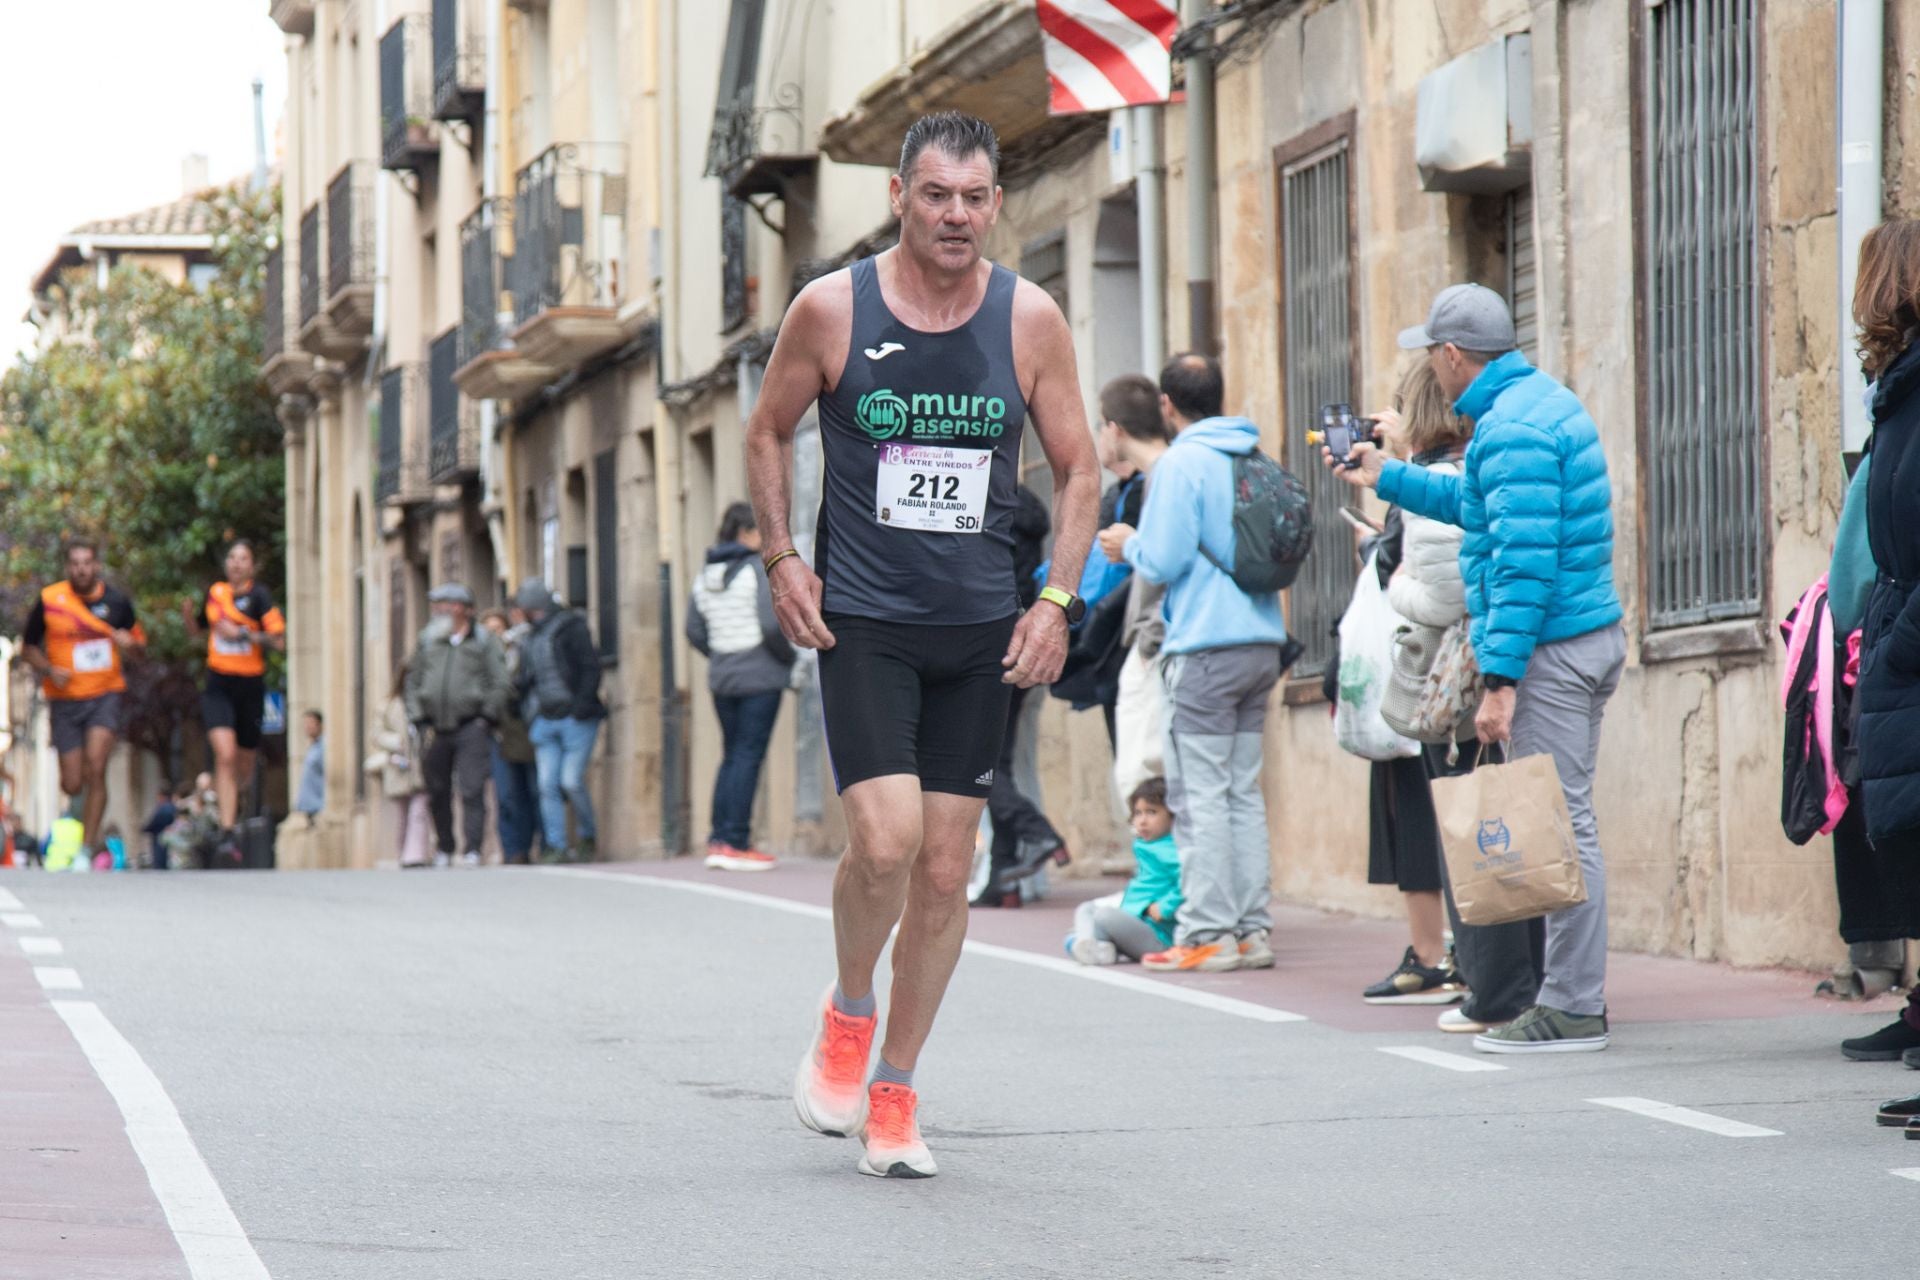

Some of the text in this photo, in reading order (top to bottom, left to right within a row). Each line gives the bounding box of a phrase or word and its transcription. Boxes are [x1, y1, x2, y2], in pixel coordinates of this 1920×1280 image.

[912, 393, 1005, 419] muro
[912, 417, 1004, 437] asensio
[886, 445, 903, 464] 18
[904, 459, 933, 467] ENTRE
[908, 473, 960, 501] 212
[897, 498, 928, 509] FABIÁN
[930, 501, 967, 511] ROLANDO
[955, 516, 980, 530] SDi
